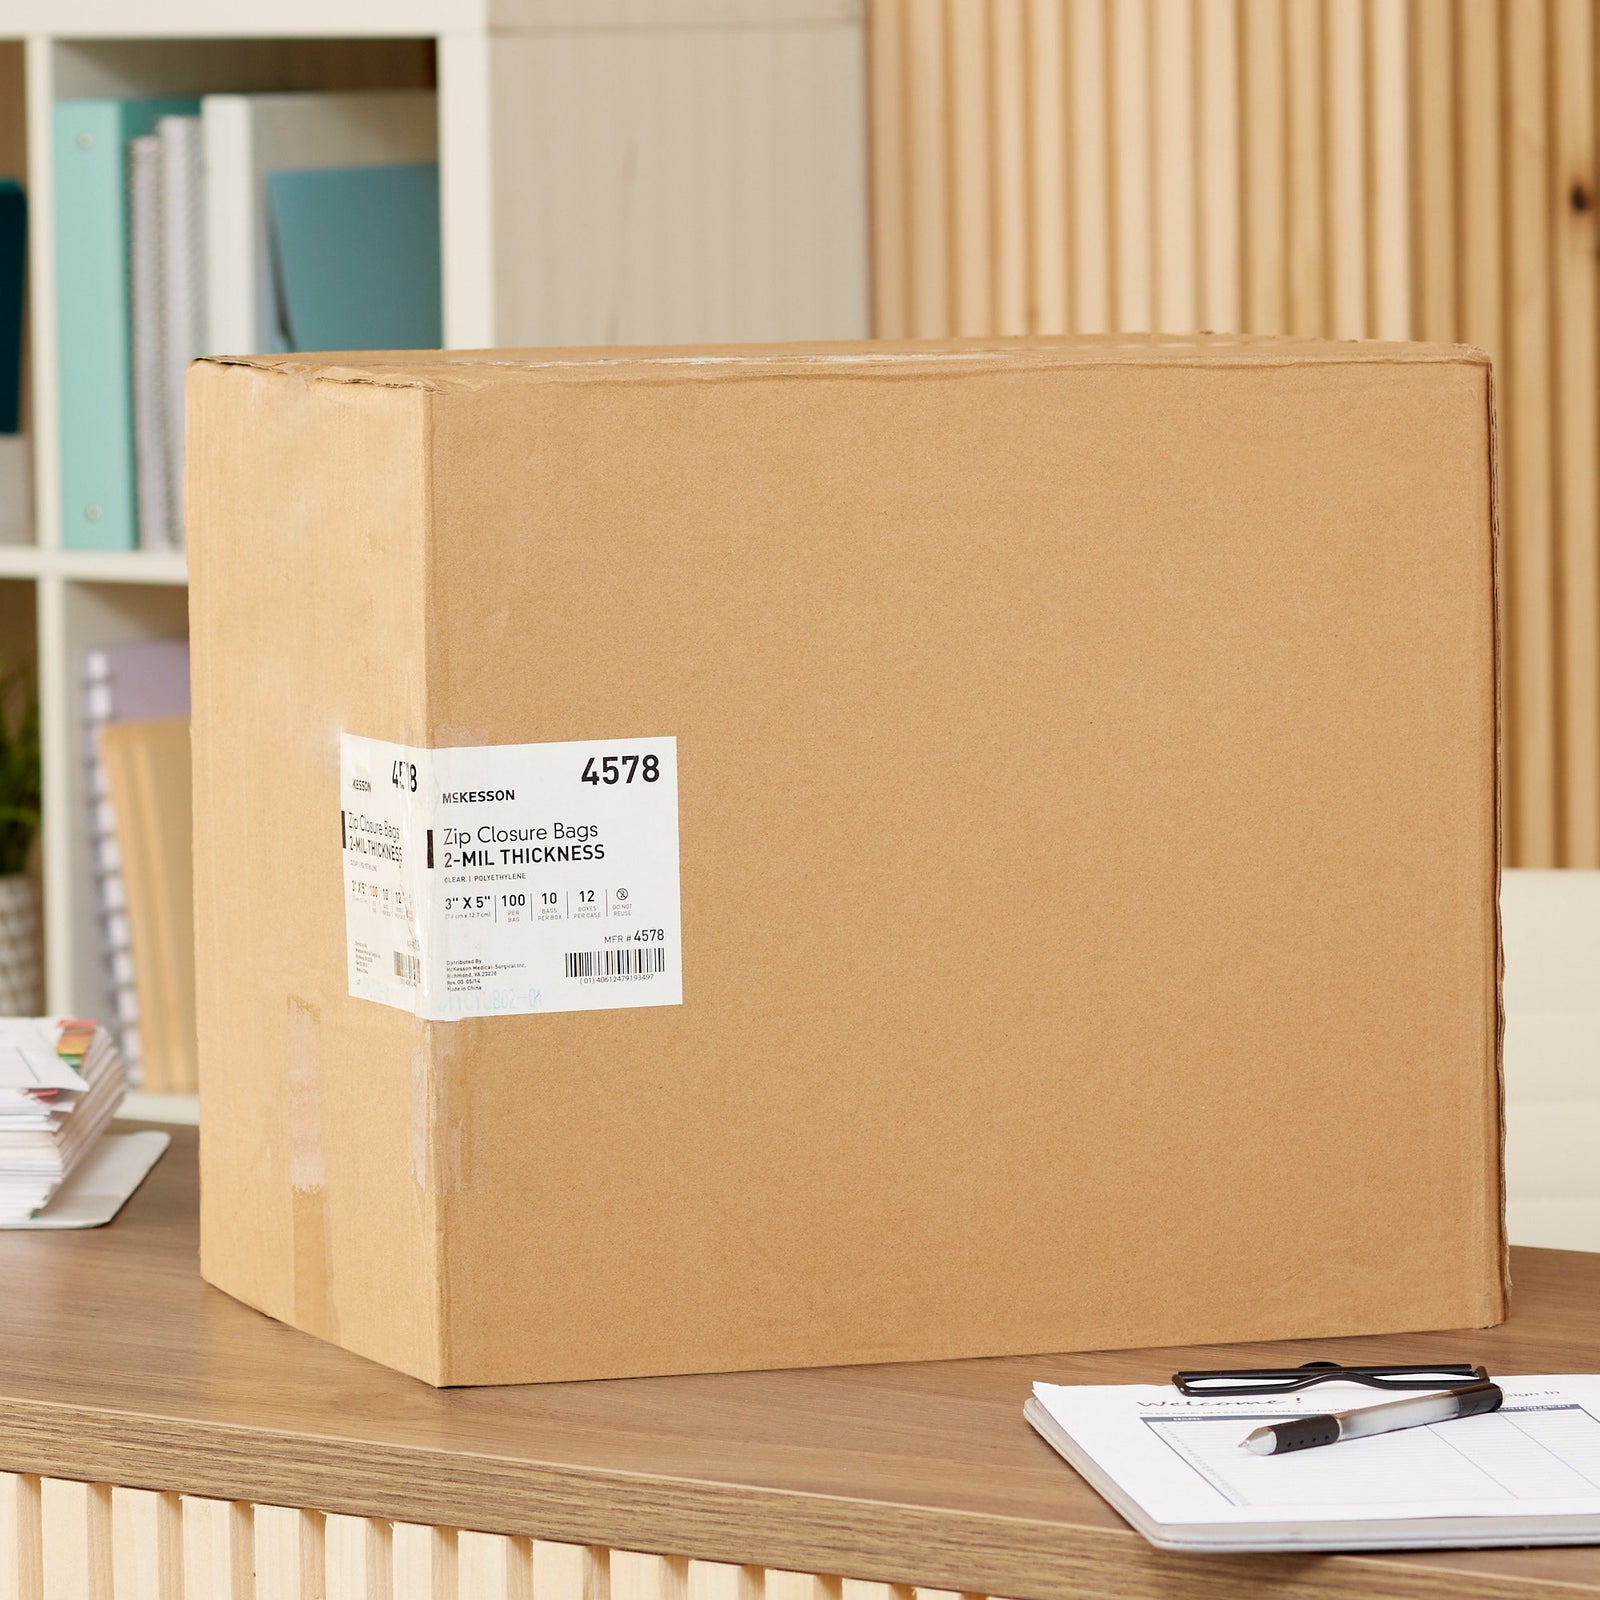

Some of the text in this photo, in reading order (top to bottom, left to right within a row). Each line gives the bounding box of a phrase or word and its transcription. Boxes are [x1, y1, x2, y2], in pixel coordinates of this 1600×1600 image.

[392, 760, 417, 793] 458
[581, 754, 660, 786] 4578
[360, 815, 382, 836] Closure
[384, 820, 400, 843] Bags
[443, 822, 598, 848] Zip Closure Bags
[350, 836, 402, 862] 2-MIL THICKNESS
[444, 844, 605, 868] 2-MIL THICKNESS
[444, 873, 527, 884] CLEAR POLYETHYLENE
[445, 896, 491, 910] 3" X 5"
[502, 894, 526, 907] 100
[542, 892, 558, 905] 10
[579, 890, 595, 902] 12
[604, 935, 623, 944] MFR
[634, 929, 664, 942] 4578
[1137, 1398, 1286, 1407] Welcome
